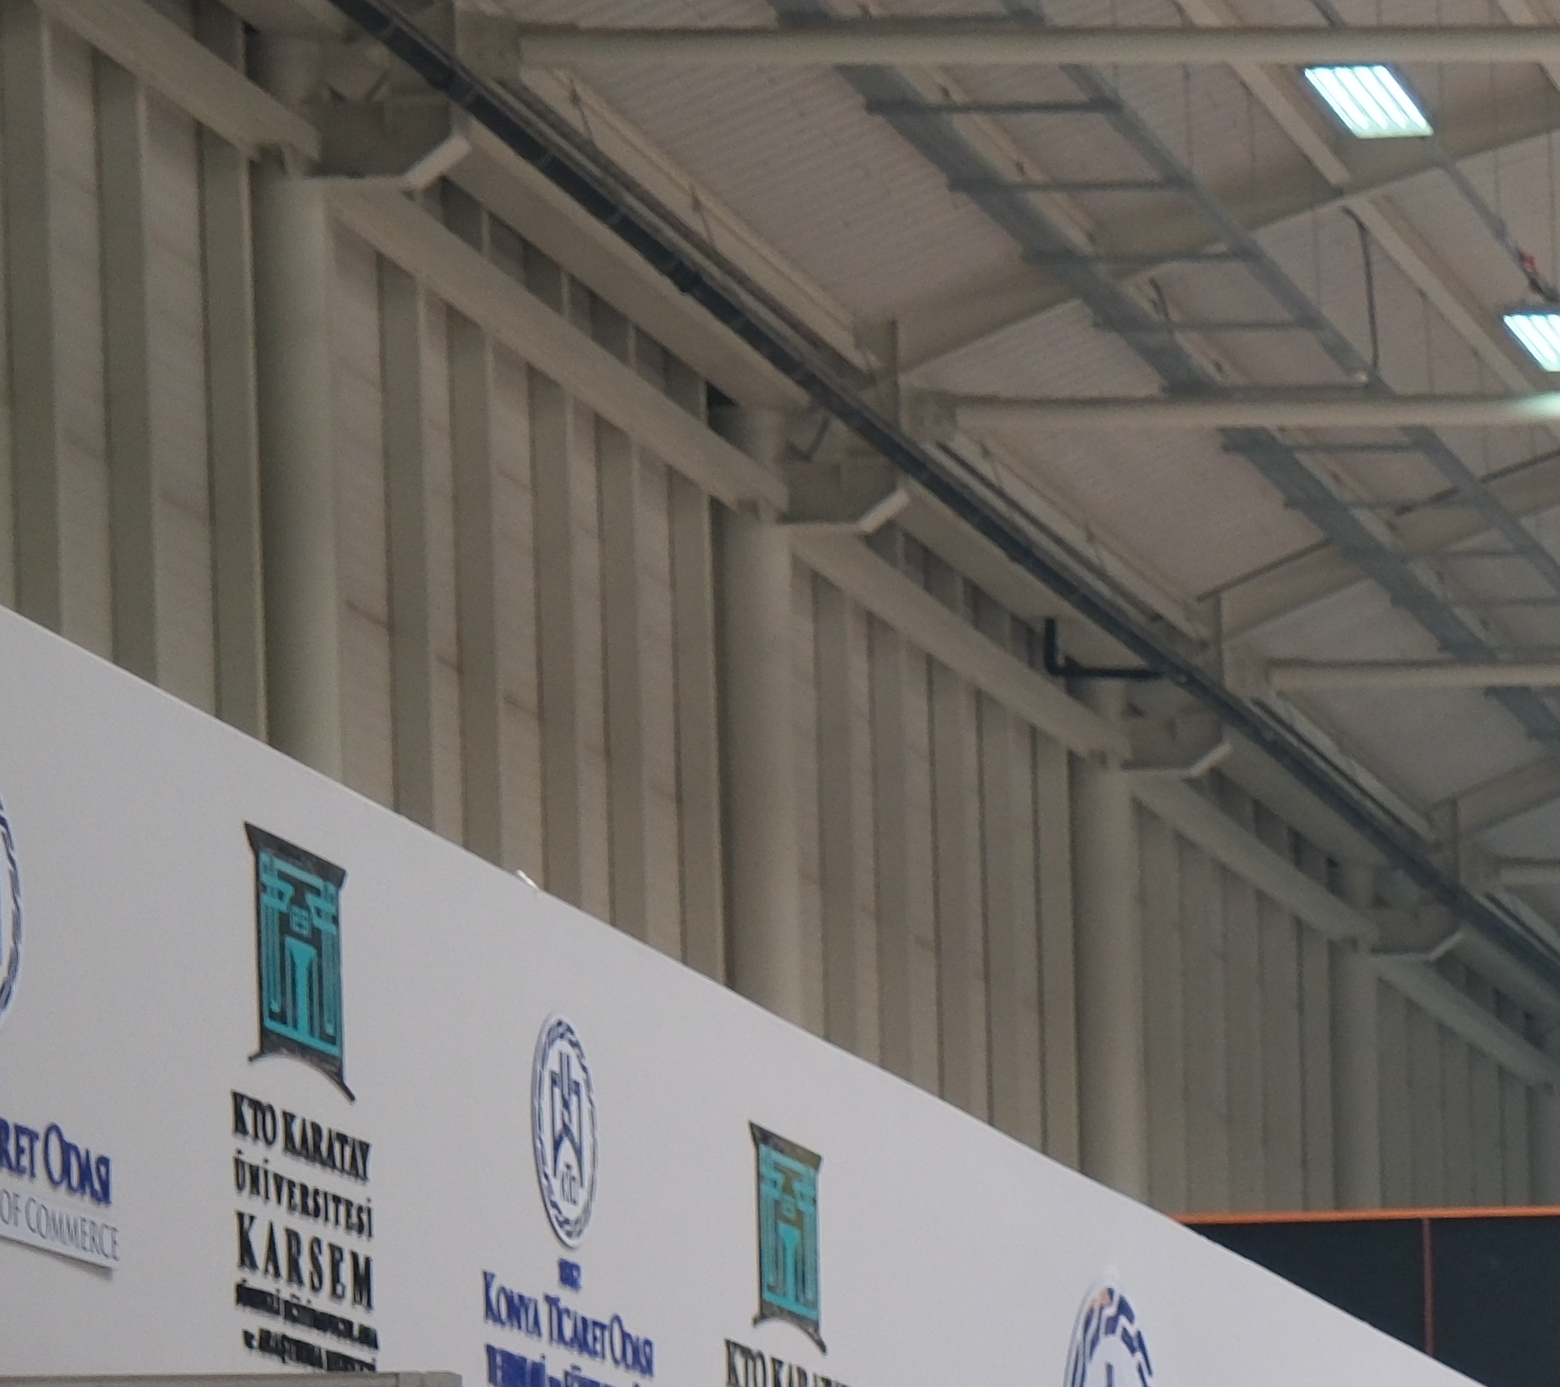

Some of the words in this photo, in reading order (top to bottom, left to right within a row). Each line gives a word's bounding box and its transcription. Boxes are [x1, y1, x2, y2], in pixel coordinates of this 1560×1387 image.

[231, 1089, 278, 1147] KTO
[281, 1109, 371, 1182] KARATAY
[236, 1210, 374, 1313] KARSEM
